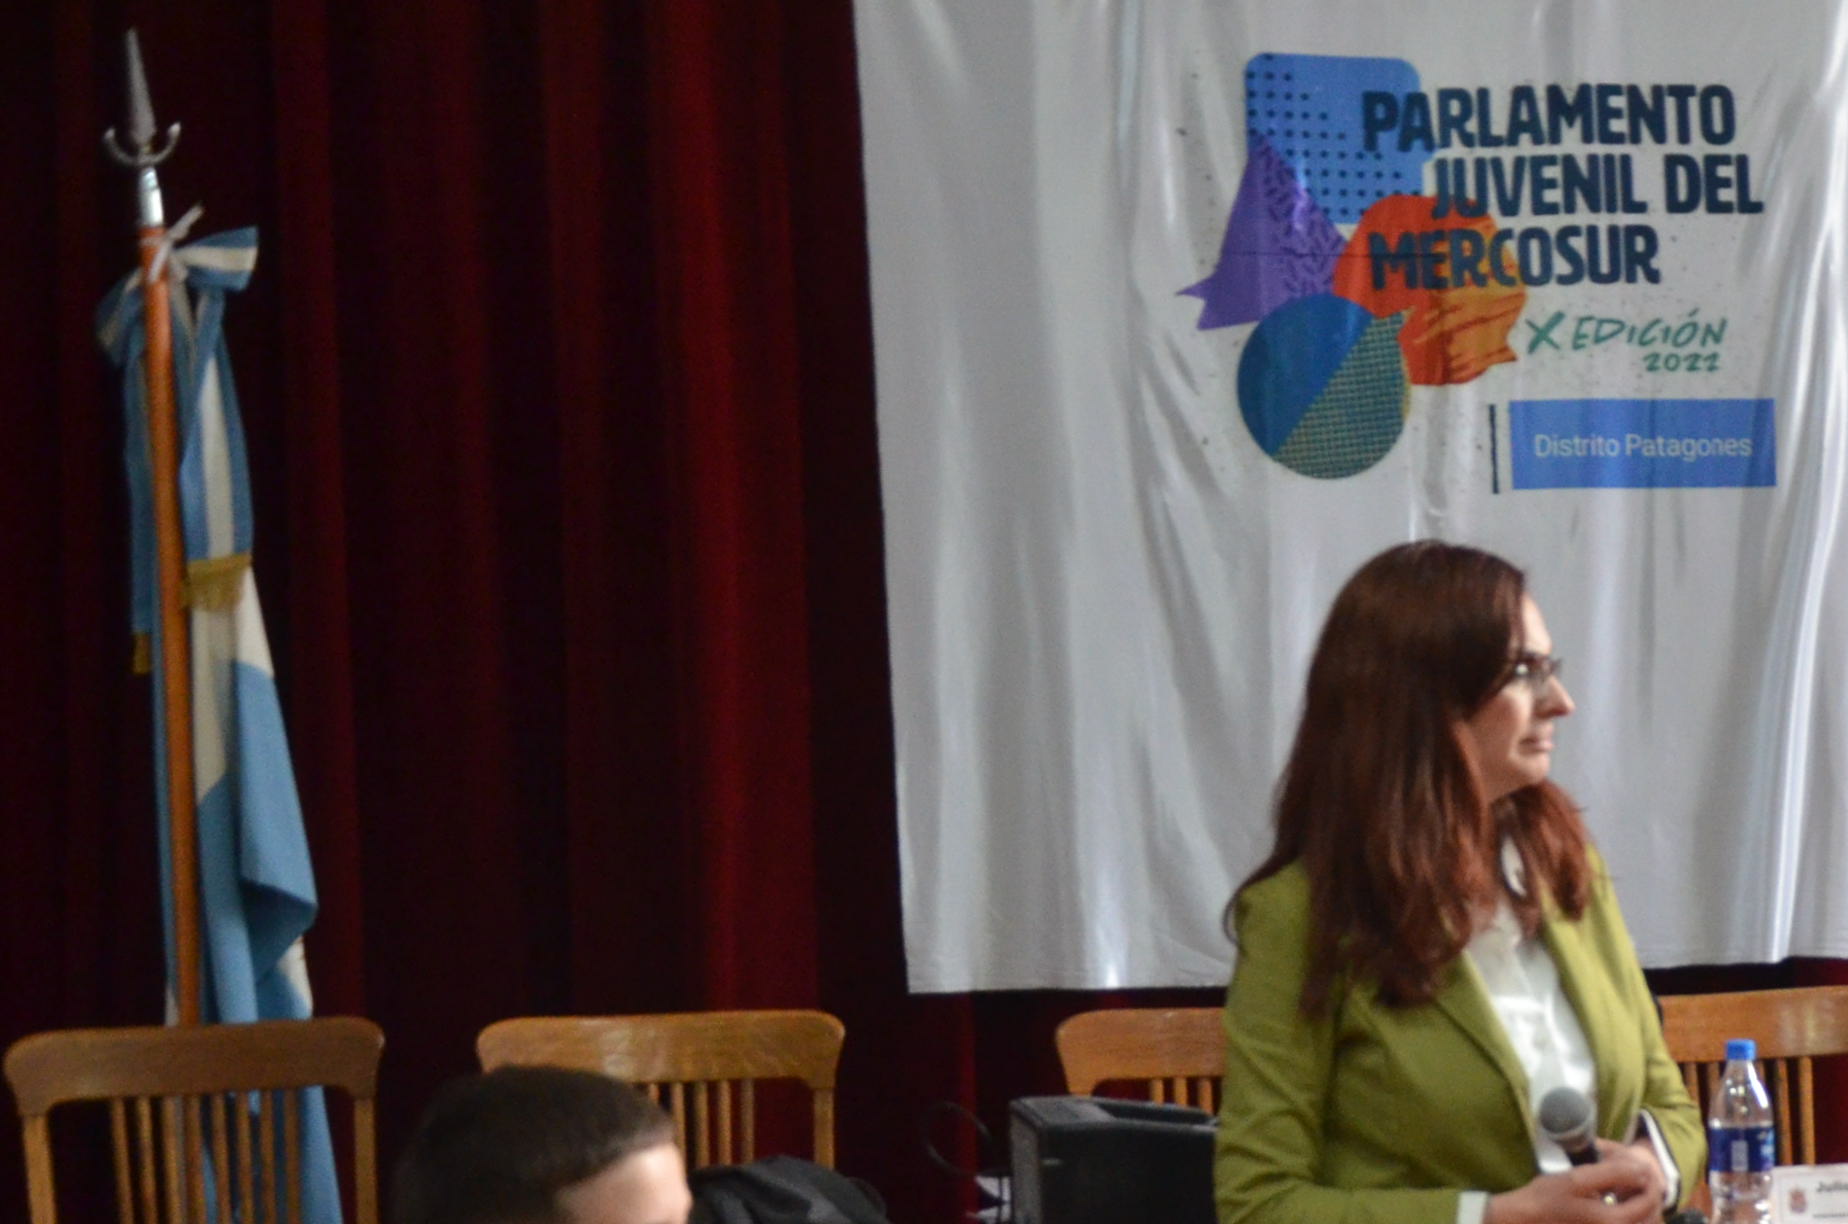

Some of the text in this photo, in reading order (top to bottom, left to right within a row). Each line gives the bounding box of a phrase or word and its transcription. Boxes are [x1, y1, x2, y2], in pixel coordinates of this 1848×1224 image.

[1361, 83, 1736, 152] PARLAMENTO
[1431, 153, 1764, 220] JUVENIL DEL
[1367, 224, 1661, 291] MERCOSUR
[1525, 308, 1728, 354] X EDICIÓN
[1643, 351, 1720, 373] 2022
[1534, 433, 1754, 463] Distrito Patagones
